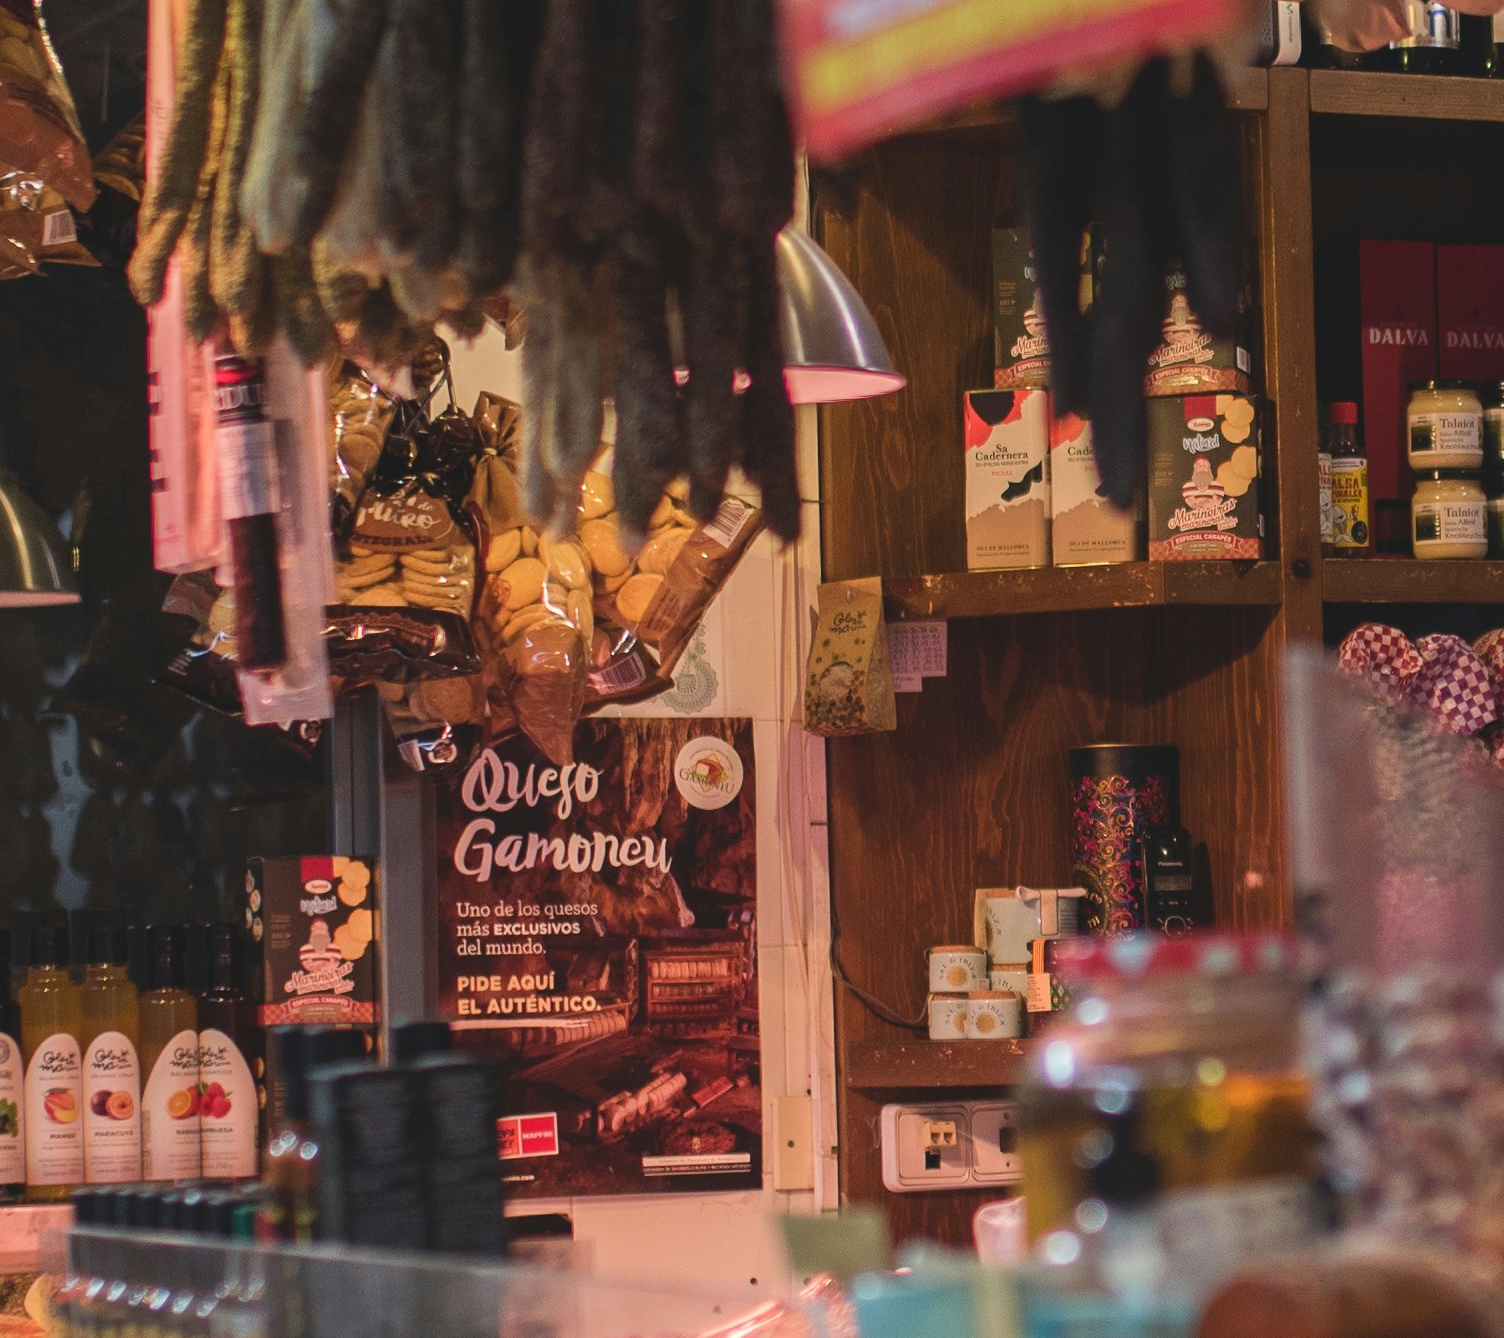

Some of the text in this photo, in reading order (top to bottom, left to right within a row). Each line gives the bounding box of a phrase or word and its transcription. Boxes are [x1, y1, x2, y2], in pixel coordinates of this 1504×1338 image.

[1369, 327, 1428, 345] DALVA
[1440, 418, 1475, 429] Talaiot
[975, 451, 1028, 462] Cadernera
[996, 444, 1008, 453] Sa
[1168, 498, 1238, 530] Marineiras
[1444, 508, 1480, 518] Talaiot
[1176, 534, 1203, 545] ESPECIAL
[462, 748, 604, 819] Queso
[454, 818, 672, 882] Gamoneu
[457, 901, 598, 920] Uno de los quesos
[456, 921, 581, 937] más EXCLUSIVOS
[457, 940, 546, 955] del mundo.
[457, 972, 555, 992] PIDE AQUÍ
[457, 994, 601, 1015] EL AUTÉNTICO.
